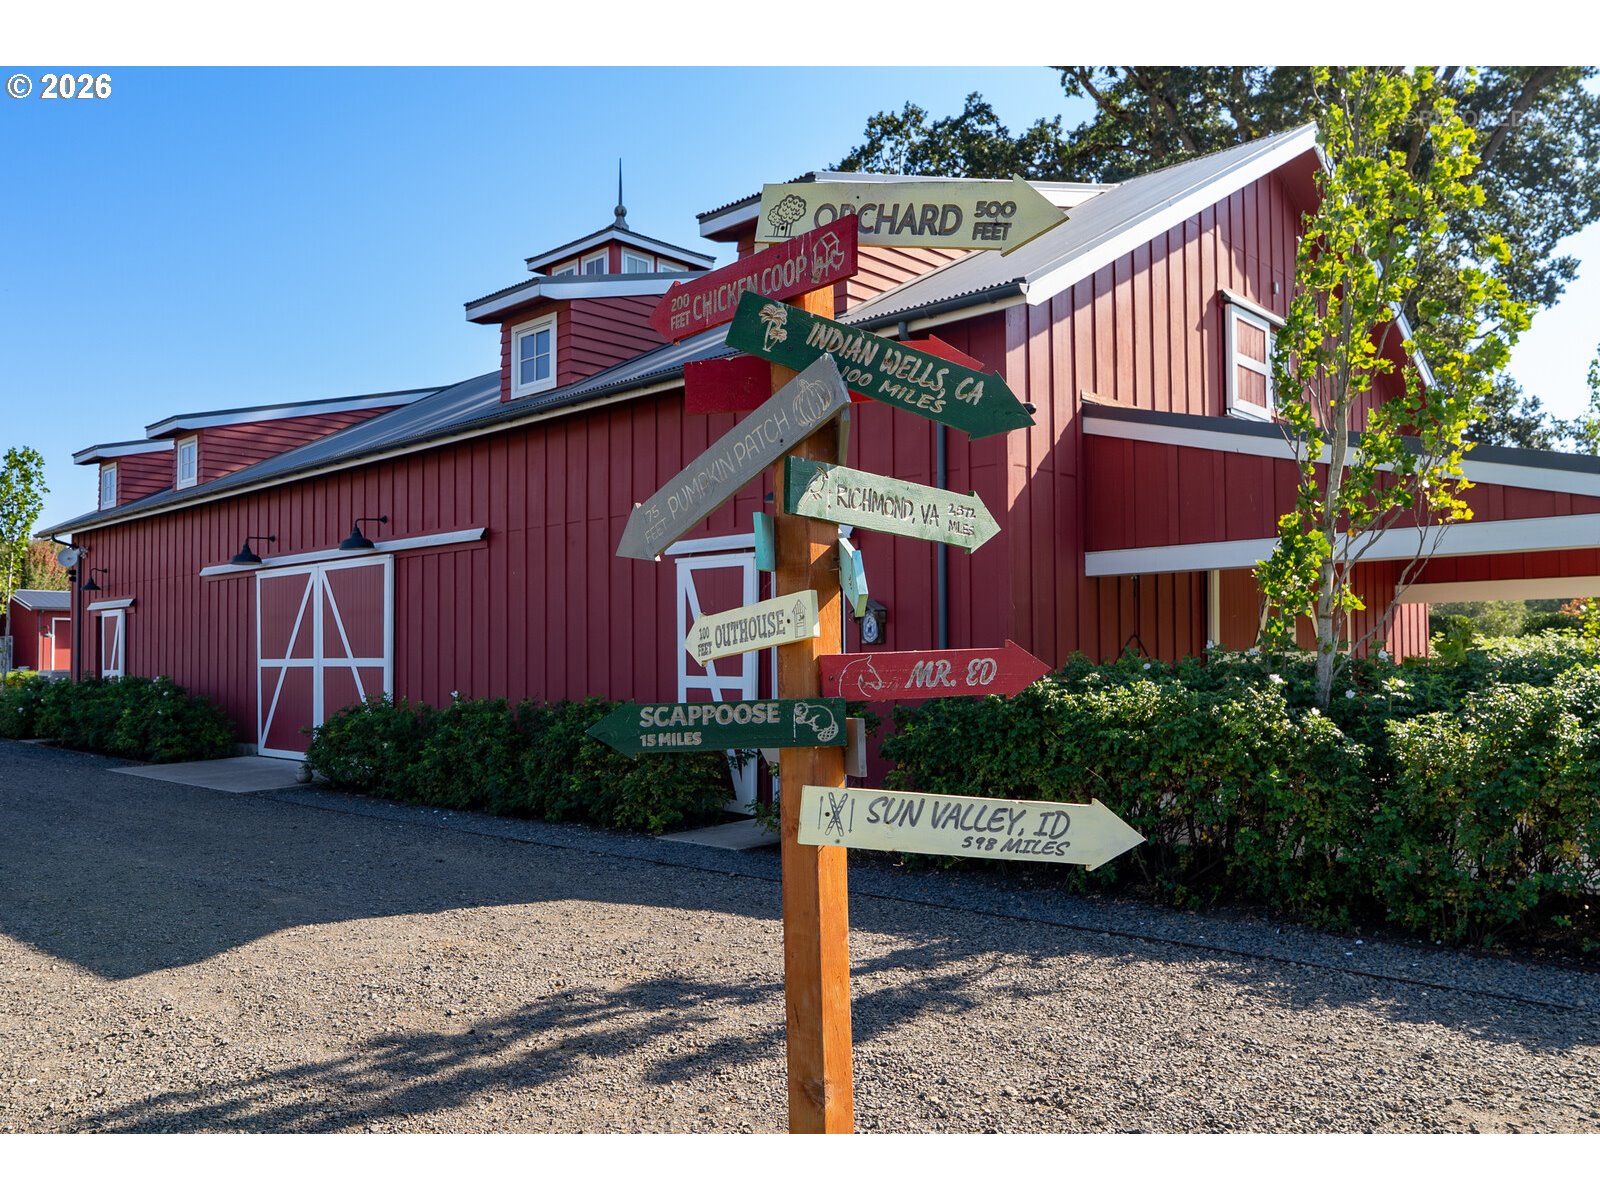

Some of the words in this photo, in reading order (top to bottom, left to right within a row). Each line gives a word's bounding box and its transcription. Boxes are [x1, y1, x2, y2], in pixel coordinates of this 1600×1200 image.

[973, 200, 1018, 219] 500
[971, 221, 1013, 241] FEET
[692, 272, 758, 321] CHICKEN
[761, 254, 808, 296] COOP
[670, 292, 690, 313] 200
[670, 309, 691, 332] FEET
[805, 321, 880, 367] INDIAN
[879, 347, 950, 399] WELLS,
[954, 376, 985, 406] CA
[878, 379, 947, 414] MILES
[667, 451, 736, 520] PUMPKIN
[733, 407, 791, 468] PATCH
[644, 504, 661, 522] 75
[836, 483, 916, 524] RICHMOND,
[920, 503, 940, 527] VA
[644, 516, 668, 544] FEET
[698, 625, 710, 641] 100
[714, 609, 786, 649] OUTHOUSE
[697, 641, 713, 657] FEET
[904, 659, 957, 689] MR.
[965, 657, 998, 686] ED
[639, 702, 781, 728] SCAPPOOSE
[639, 733, 657, 747] 15
[658, 731, 703, 747] MILES
[866, 795, 927, 828] SUN
[931, 800, 1027, 837] VALLEY,
[1033, 809, 1071, 840] ID
[961, 835, 999, 851] 598
[1000, 837, 1071, 857] MILES
